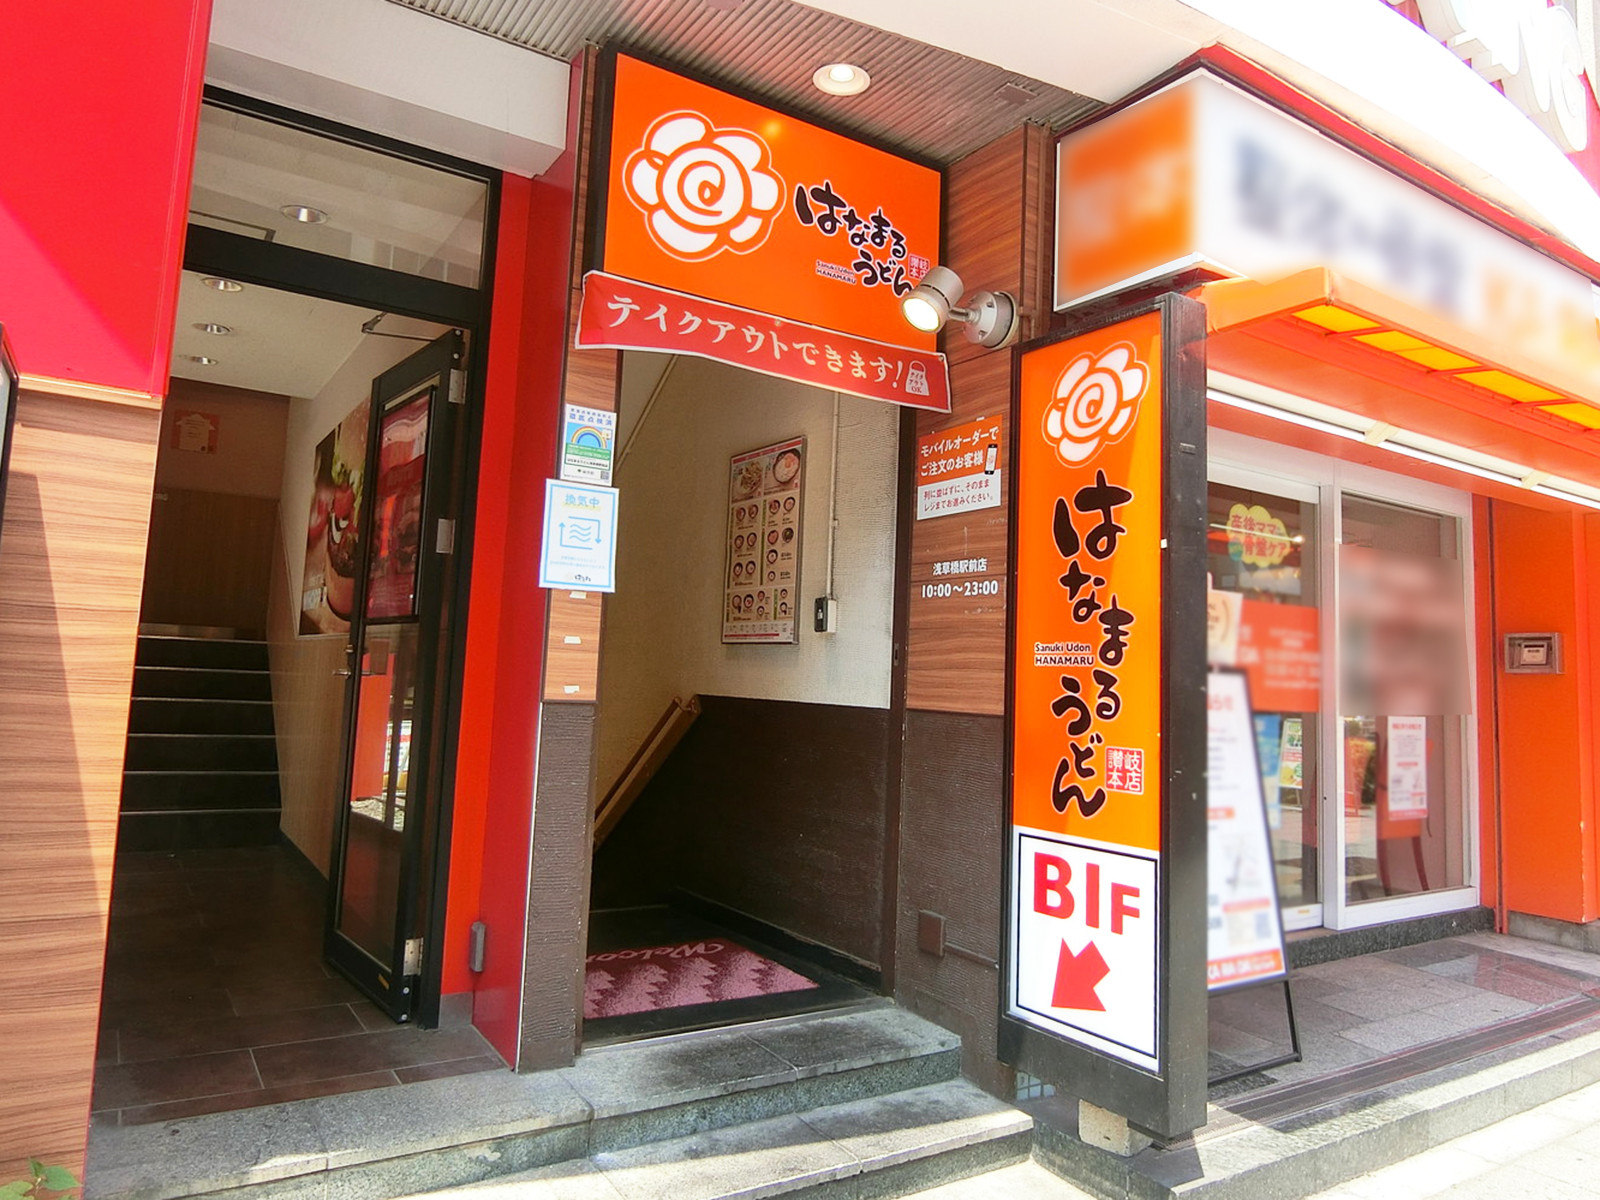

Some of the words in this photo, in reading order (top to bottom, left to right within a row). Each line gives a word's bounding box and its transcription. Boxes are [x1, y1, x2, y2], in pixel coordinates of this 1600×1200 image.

[794, 180, 906, 259] はなまる
[816, 268, 857, 285] HANAMARU
[852, 249, 913, 297] うどん
[920, 426, 999, 457] モバイルオーダーで
[920, 449, 984, 476] ご注文のお客様
[932, 558, 988, 576] 浅草橋駅前店
[1052, 469, 1135, 721] はなまる
[1035, 643, 1064, 652] Sanuki
[1066, 643, 1091, 652] Udon
[1035, 656, 1094, 665] HANAMARU
[1051, 674, 1106, 818] うどん
[1107, 771, 1141, 791] 本店
